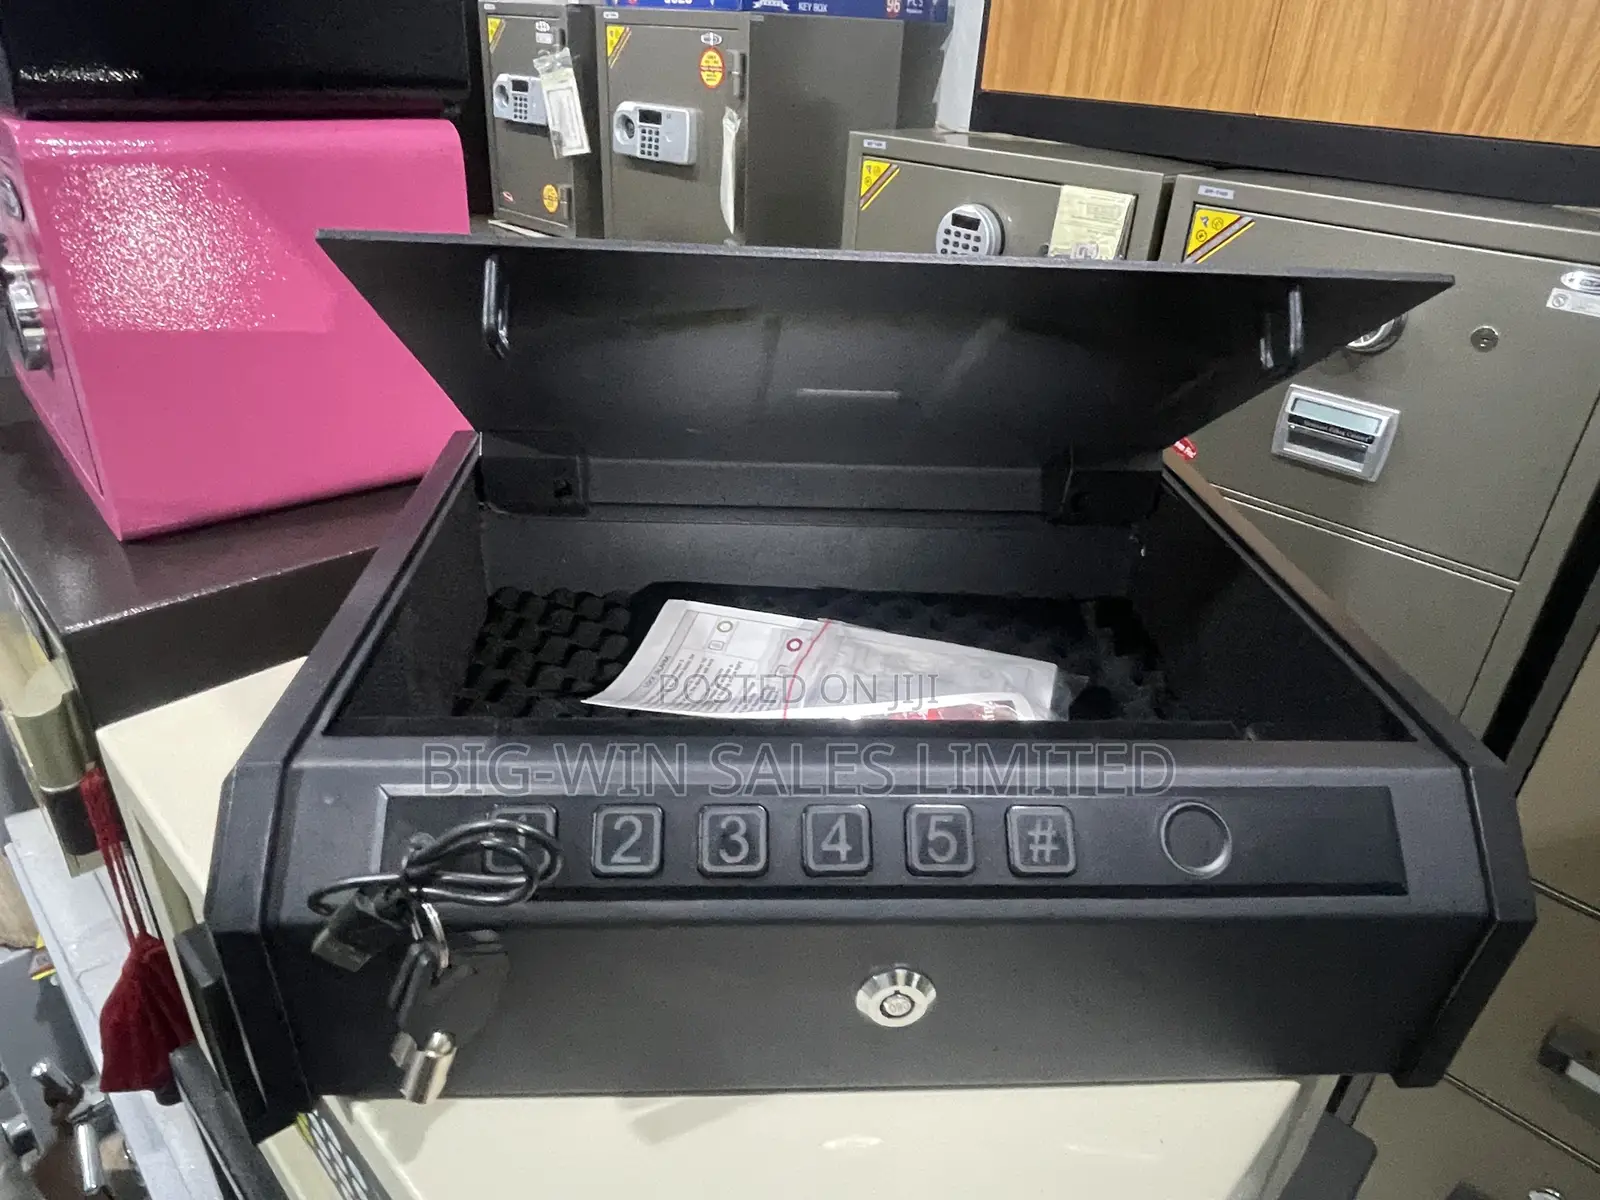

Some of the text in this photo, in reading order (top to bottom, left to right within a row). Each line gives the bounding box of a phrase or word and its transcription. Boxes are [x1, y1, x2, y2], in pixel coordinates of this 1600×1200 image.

[798, 2, 828, 12] KEY BOX
[886, 0, 900, 13] 96
[610, 814, 1059, 864] 2 3 4 5 #
